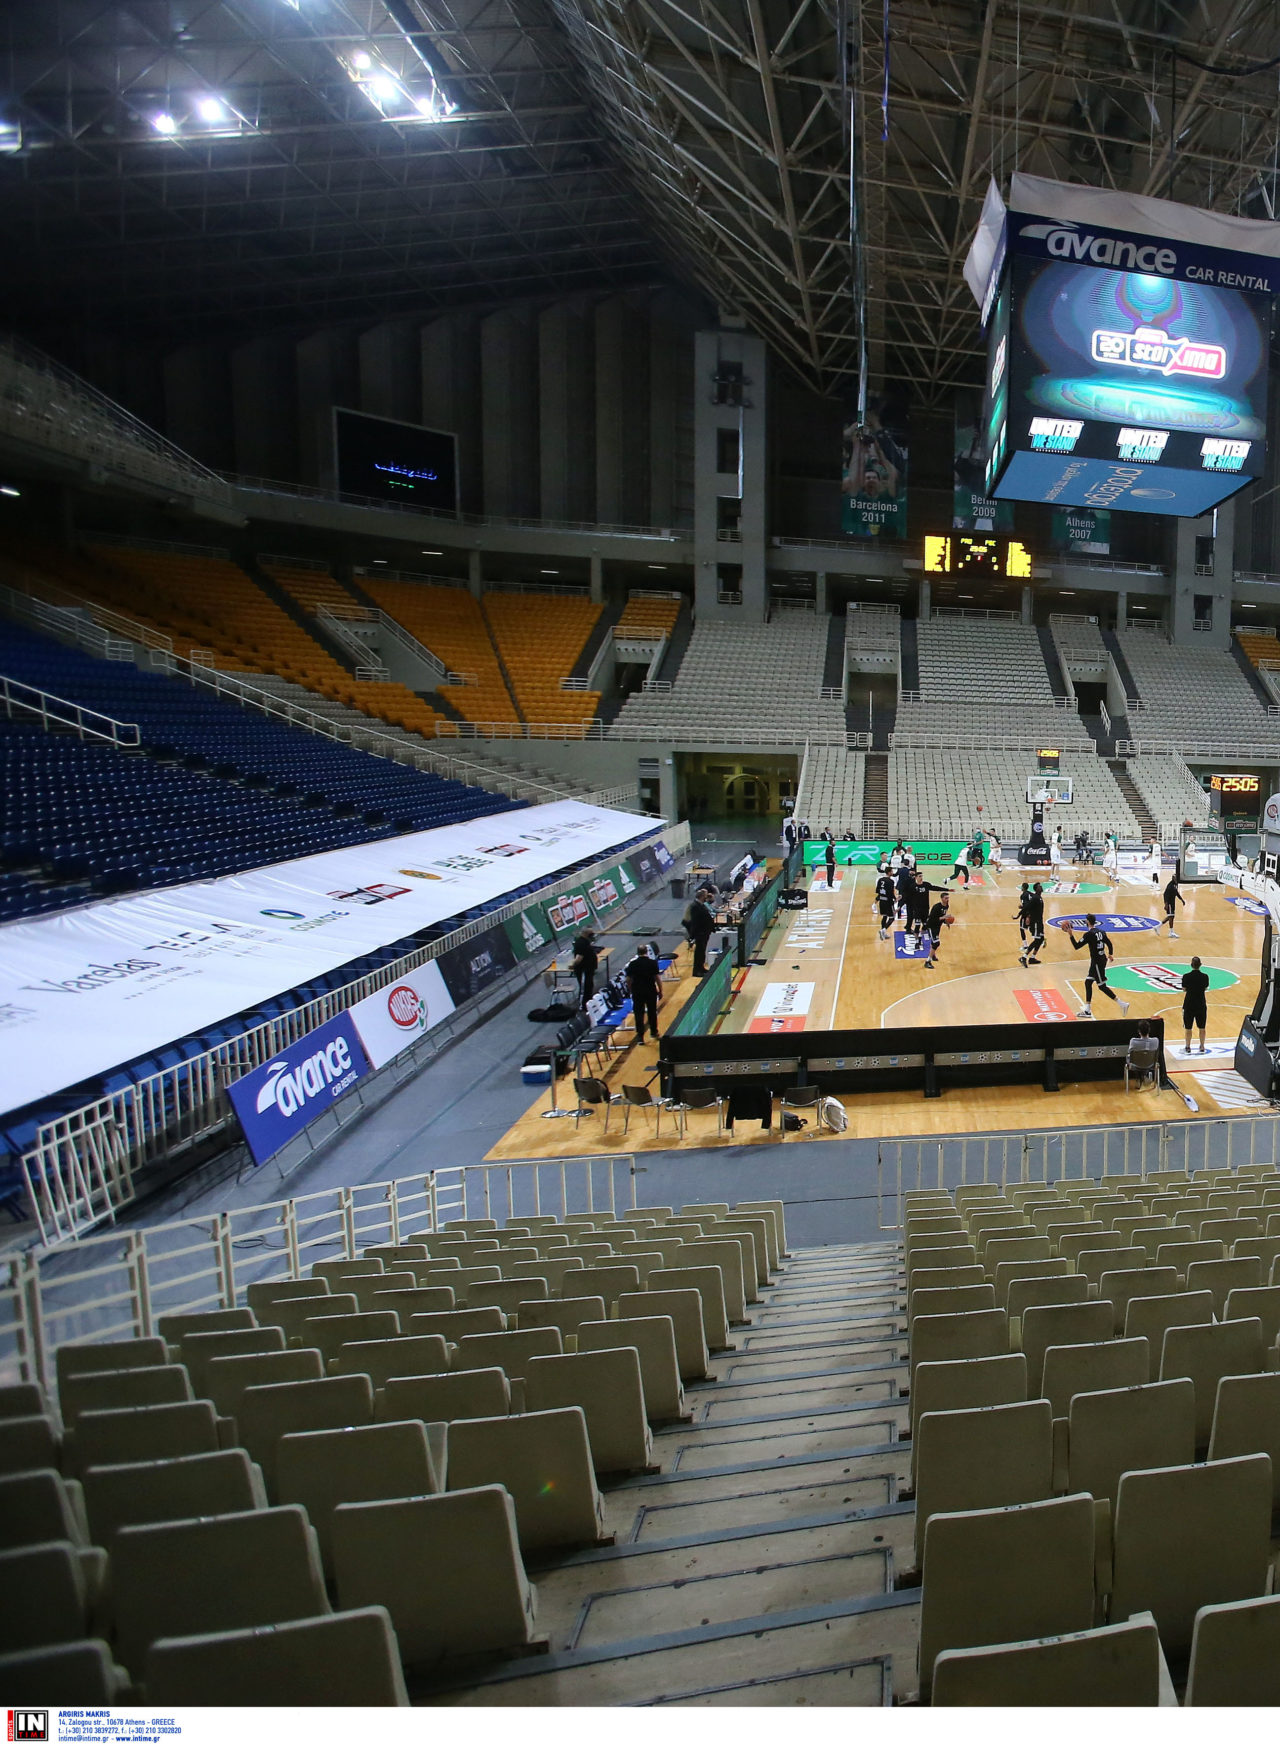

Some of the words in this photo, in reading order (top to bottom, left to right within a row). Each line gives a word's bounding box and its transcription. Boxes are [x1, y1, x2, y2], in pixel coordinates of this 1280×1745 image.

[1047, 229, 1177, 274] avance
[1185, 265, 1214, 282] CAR
[1217, 273, 1272, 293] RENTAL
[850, 499, 898, 512] Barcelona
[972, 507, 996, 518] 2009
[861, 512, 886, 523] 2011
[1066, 517, 1096, 529] Athens
[1069, 529, 1092, 540] 2007
[1222, 777, 1259, 791] 25:05
[785, 908, 834, 949] ATHENS
[1095, 932, 1103, 941] 10
[18, 957, 162, 994] Varelas
[390, 990, 418, 1022] NIKAS
[276, 1036, 353, 1118] avance
[332, 1084, 343, 1097] CAR
[342, 1070, 359, 1093] RENTAL
